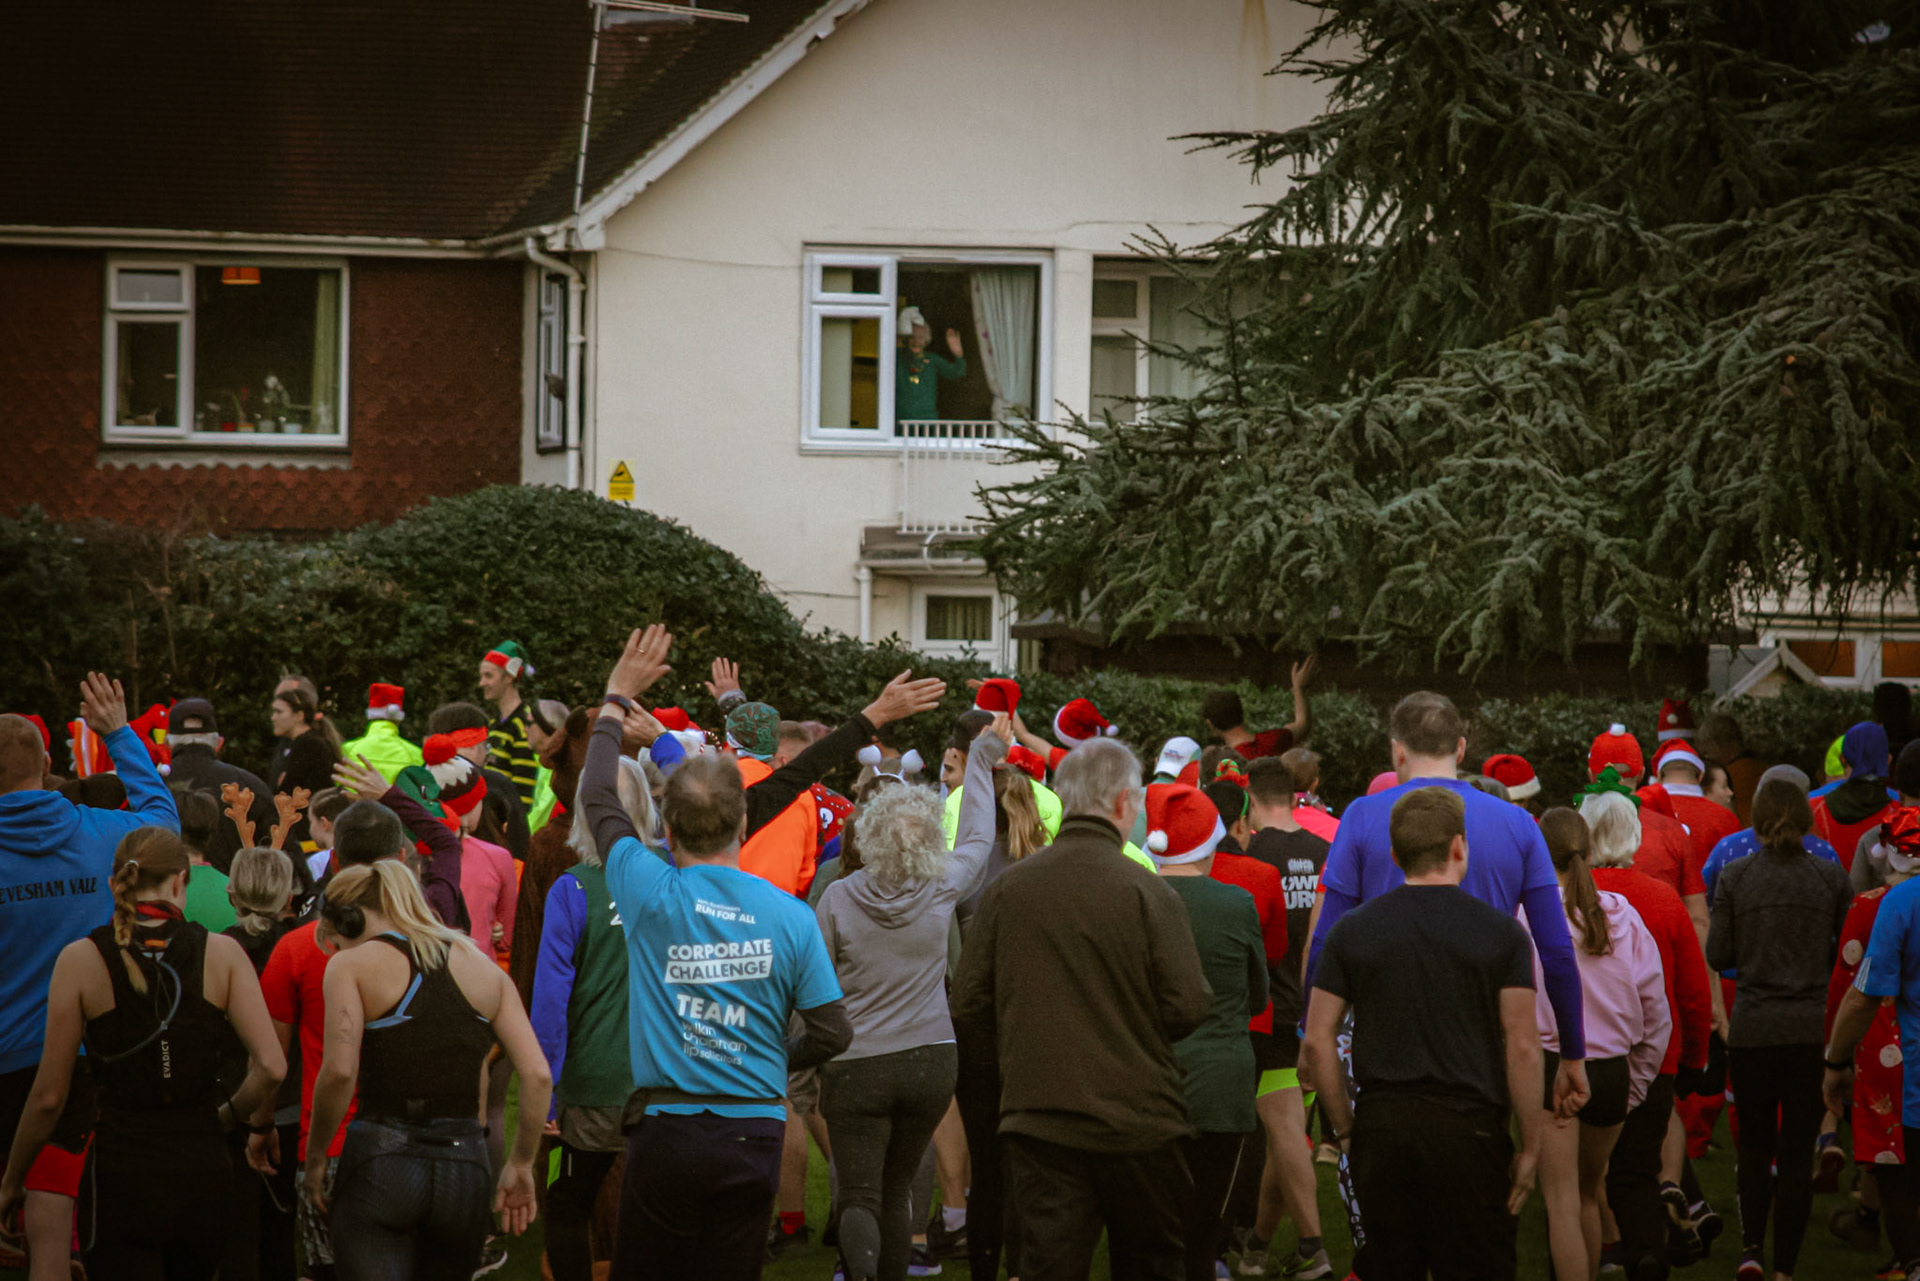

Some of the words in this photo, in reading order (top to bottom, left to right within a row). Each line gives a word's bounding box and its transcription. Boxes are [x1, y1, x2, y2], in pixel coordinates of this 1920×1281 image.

[695, 903, 715, 917] RUN
[716, 910, 737, 921] FOR
[738, 913, 756, 925] ALL
[667, 938, 772, 960] CORPORATE
[669, 960, 768, 980] CHALLENGE
[676, 994, 746, 1027] TEAM
[161, 1040, 171, 1079] EVADICT
